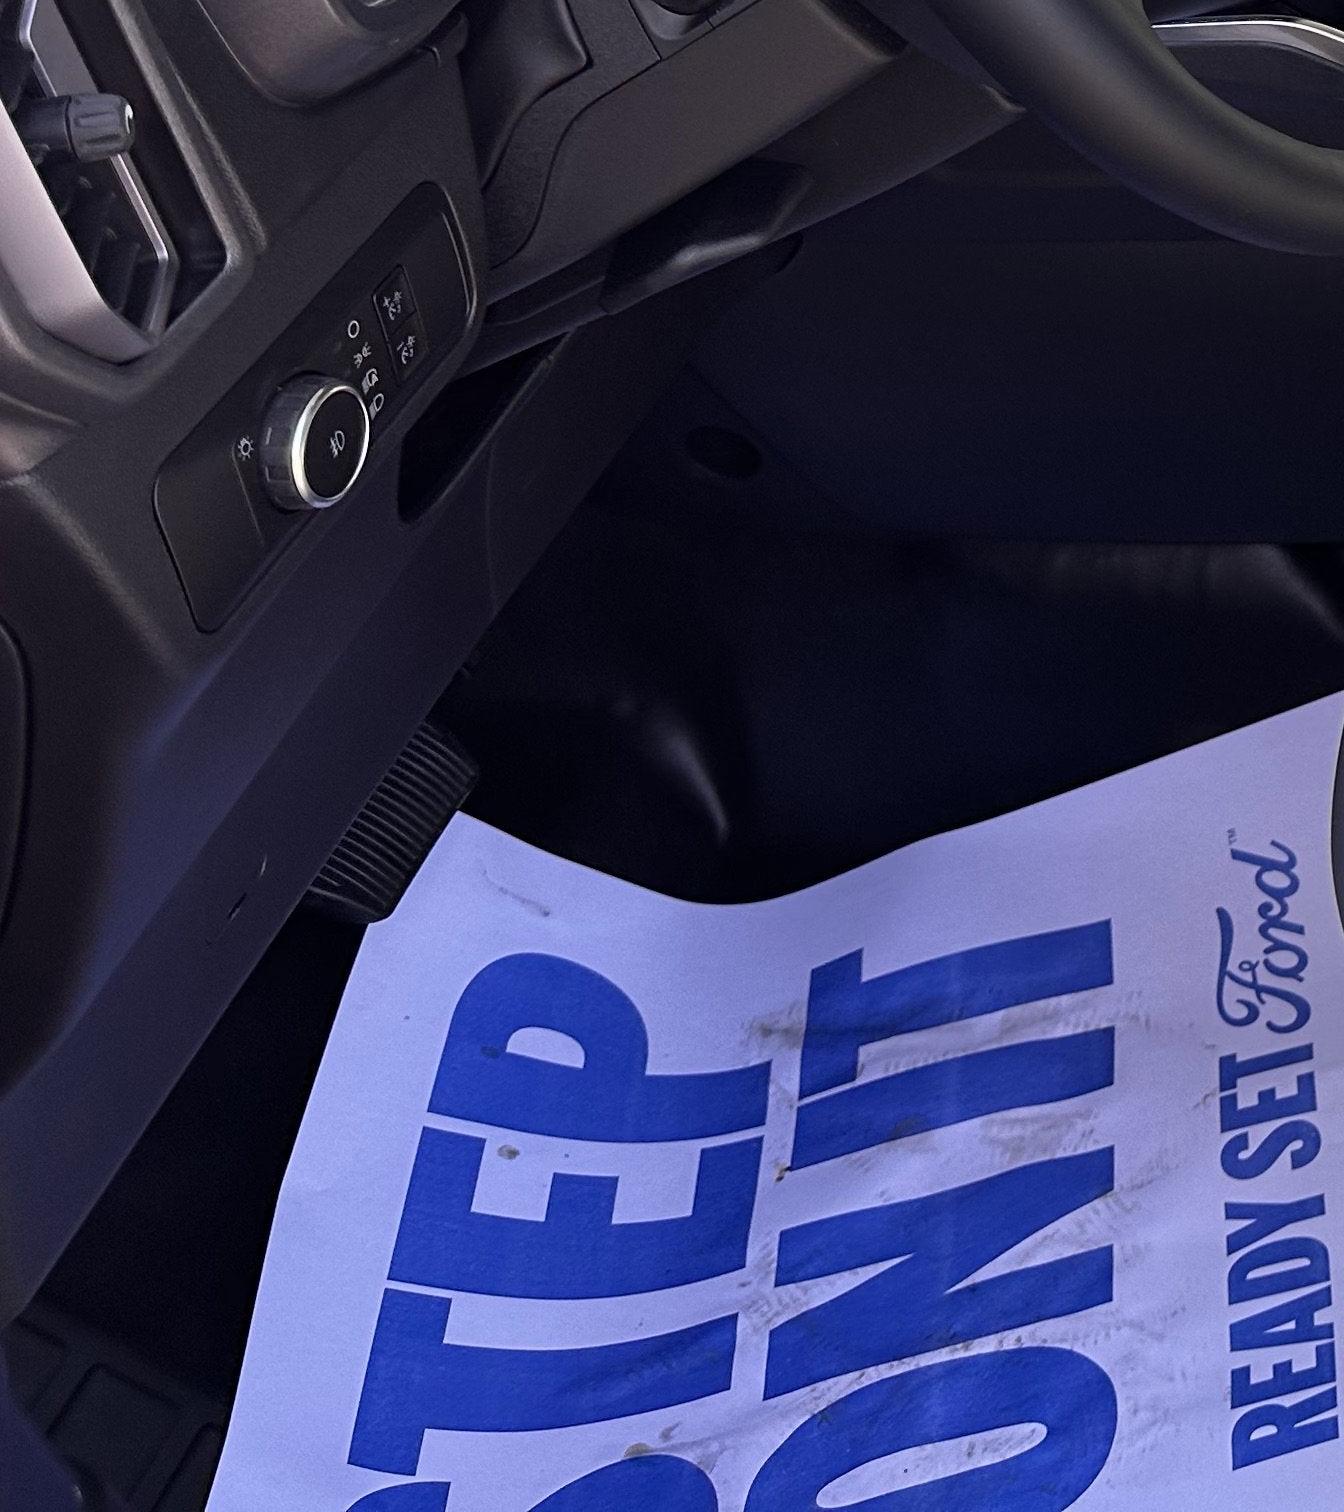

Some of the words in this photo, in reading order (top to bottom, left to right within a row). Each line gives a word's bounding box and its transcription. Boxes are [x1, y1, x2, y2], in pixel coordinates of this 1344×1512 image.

[790, 918, 1115, 1172] IT
[1215, 839, 1312, 1034] Ford
[1218, 1042, 1322, 1180] SET
[1225, 1192, 1340, 1471] READY
